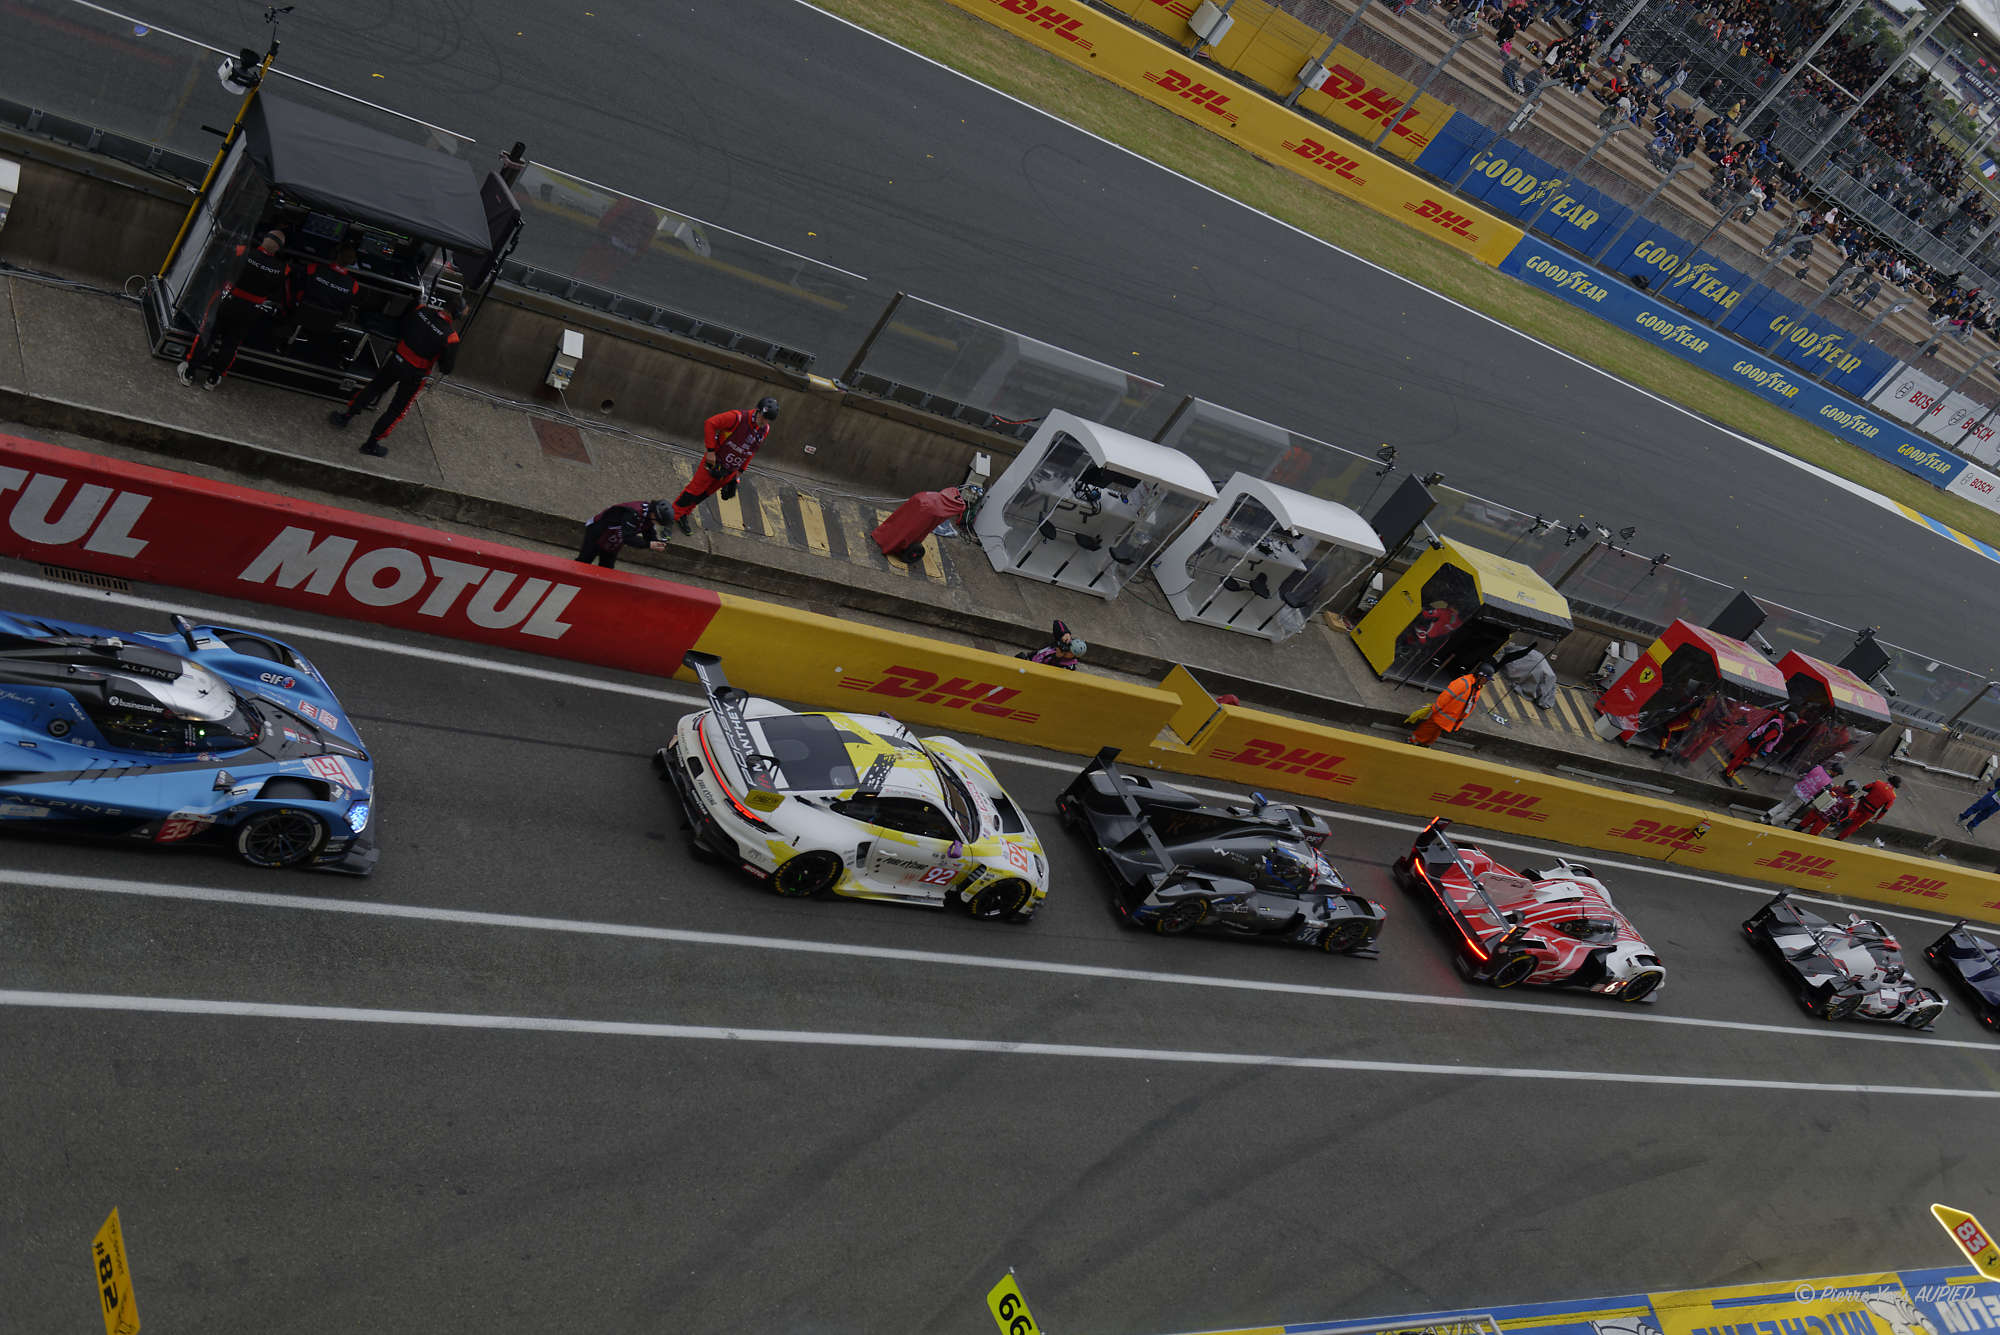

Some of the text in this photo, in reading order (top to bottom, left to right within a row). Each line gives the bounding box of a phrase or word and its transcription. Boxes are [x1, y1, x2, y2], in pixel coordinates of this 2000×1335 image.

[998, 0, 1083, 42] DHL
[1156, 69, 1231, 115] DHL
[1320, 64, 1420, 137] DHL
[1294, 138, 1359, 181] DHL
[1415, 200, 1473, 236] DHL
[1526, 255, 1608, 303] GOODYEAR
[1634, 240, 1741, 309] GOODYEAR
[1636, 312, 1709, 354] GOODYEAR
[1733, 360, 1799, 399] GOODYEAR
[1909, 390, 1945, 416] BOSH
[1820, 405, 1880, 440] GOODYEAR
[1897, 443, 1952, 475] GOODYEAR
[1970, 477, 1995, 495] BOSCH
[238, 525, 582, 639] MOTUL
[120, 663, 178, 679] ALPINE
[259, 671, 284, 685] elf
[868, 665, 1022, 716] DHL
[693, 661, 757, 787] PORSCHE
[1232, 739, 1347, 781] DHL
[6, 795, 123, 817] ALPINE
[1447, 783, 1541, 818] DHL
[160, 820, 197, 840] 35
[1621, 819, 1696, 850] DHL
[1008, 843, 1026, 867] 92
[1768, 850, 1837, 877] DHL
[925, 868, 957, 885] 92
[1887, 874, 1948, 898] DHL
[1296, 926, 1320, 945] 37
[1604, 981, 1619, 993] 6
[1957, 1222, 1987, 1253] 83
[999, 1293, 1033, 1335] 66
